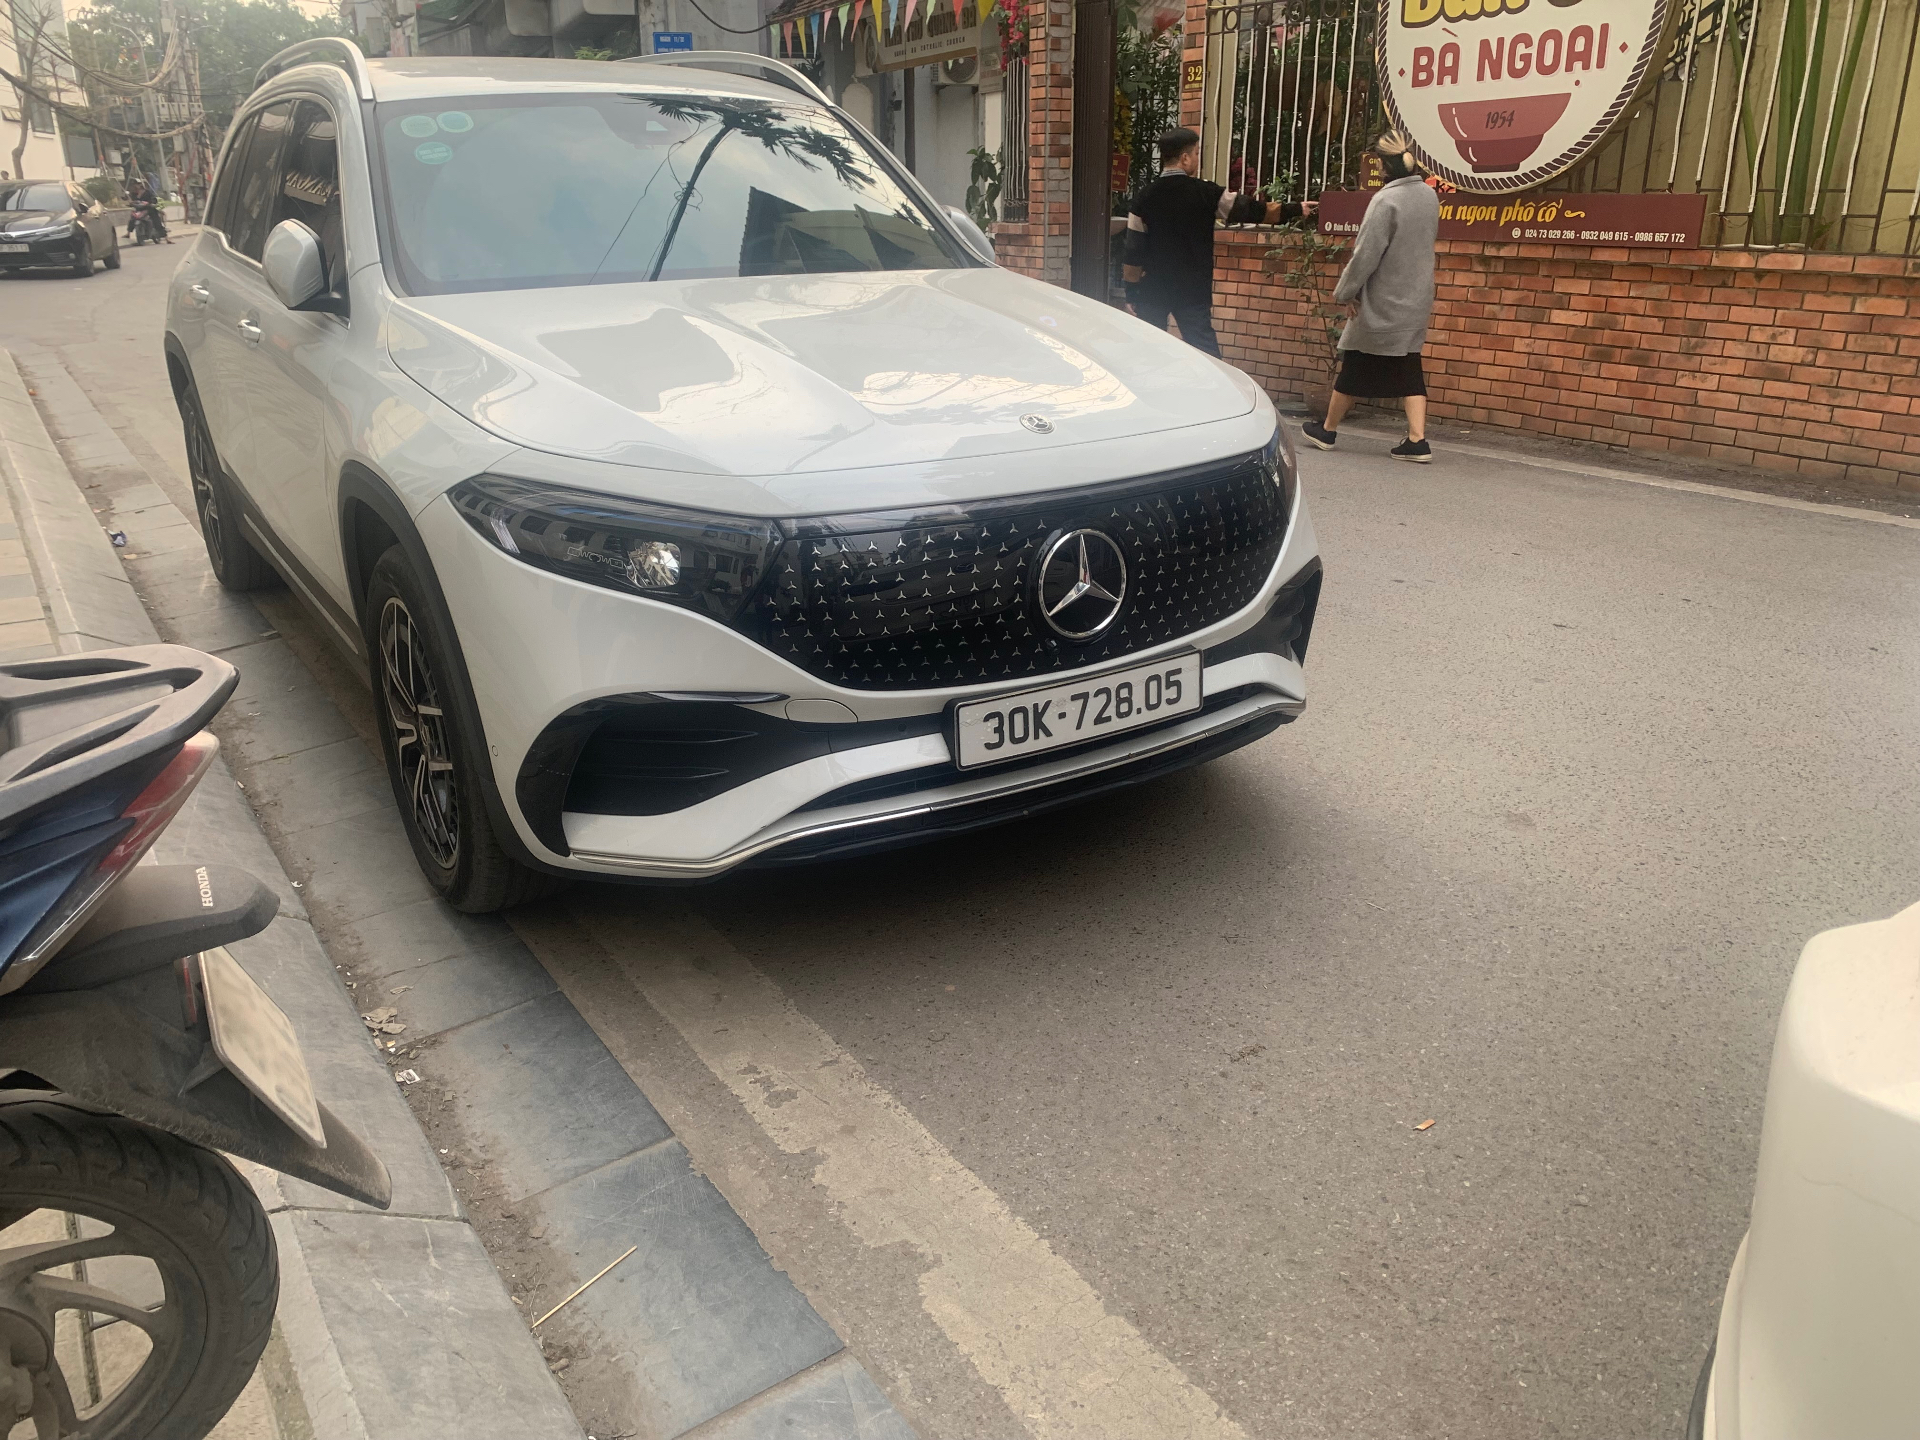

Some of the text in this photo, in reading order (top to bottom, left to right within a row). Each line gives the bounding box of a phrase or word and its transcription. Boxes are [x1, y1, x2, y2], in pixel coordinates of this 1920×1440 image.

[1411, 23, 1610, 88] BÀ NGOẠI
[1187, 65, 1203, 82] 32
[1485, 110, 1515, 130] 1954
[1456, 205, 1498, 226] ngon
[1525, 228, 1537, 238] 024
[1538, 229, 1548, 239] 73
[1548, 229, 1561, 239] 029
[1562, 230, 1575, 240] 266
[1581, 230, 1598, 240] 0932
[1599, 231, 1614, 241] 049
[1614, 231, 1629, 241] 615
[1634, 231, 1653, 242] 0986
[1654, 232, 1669, 242] 657
[1671, 233, 1686, 243] 172
[983, 667, 1182, 751] 30K-728.05
[195, 866, 214, 907] HONDA
